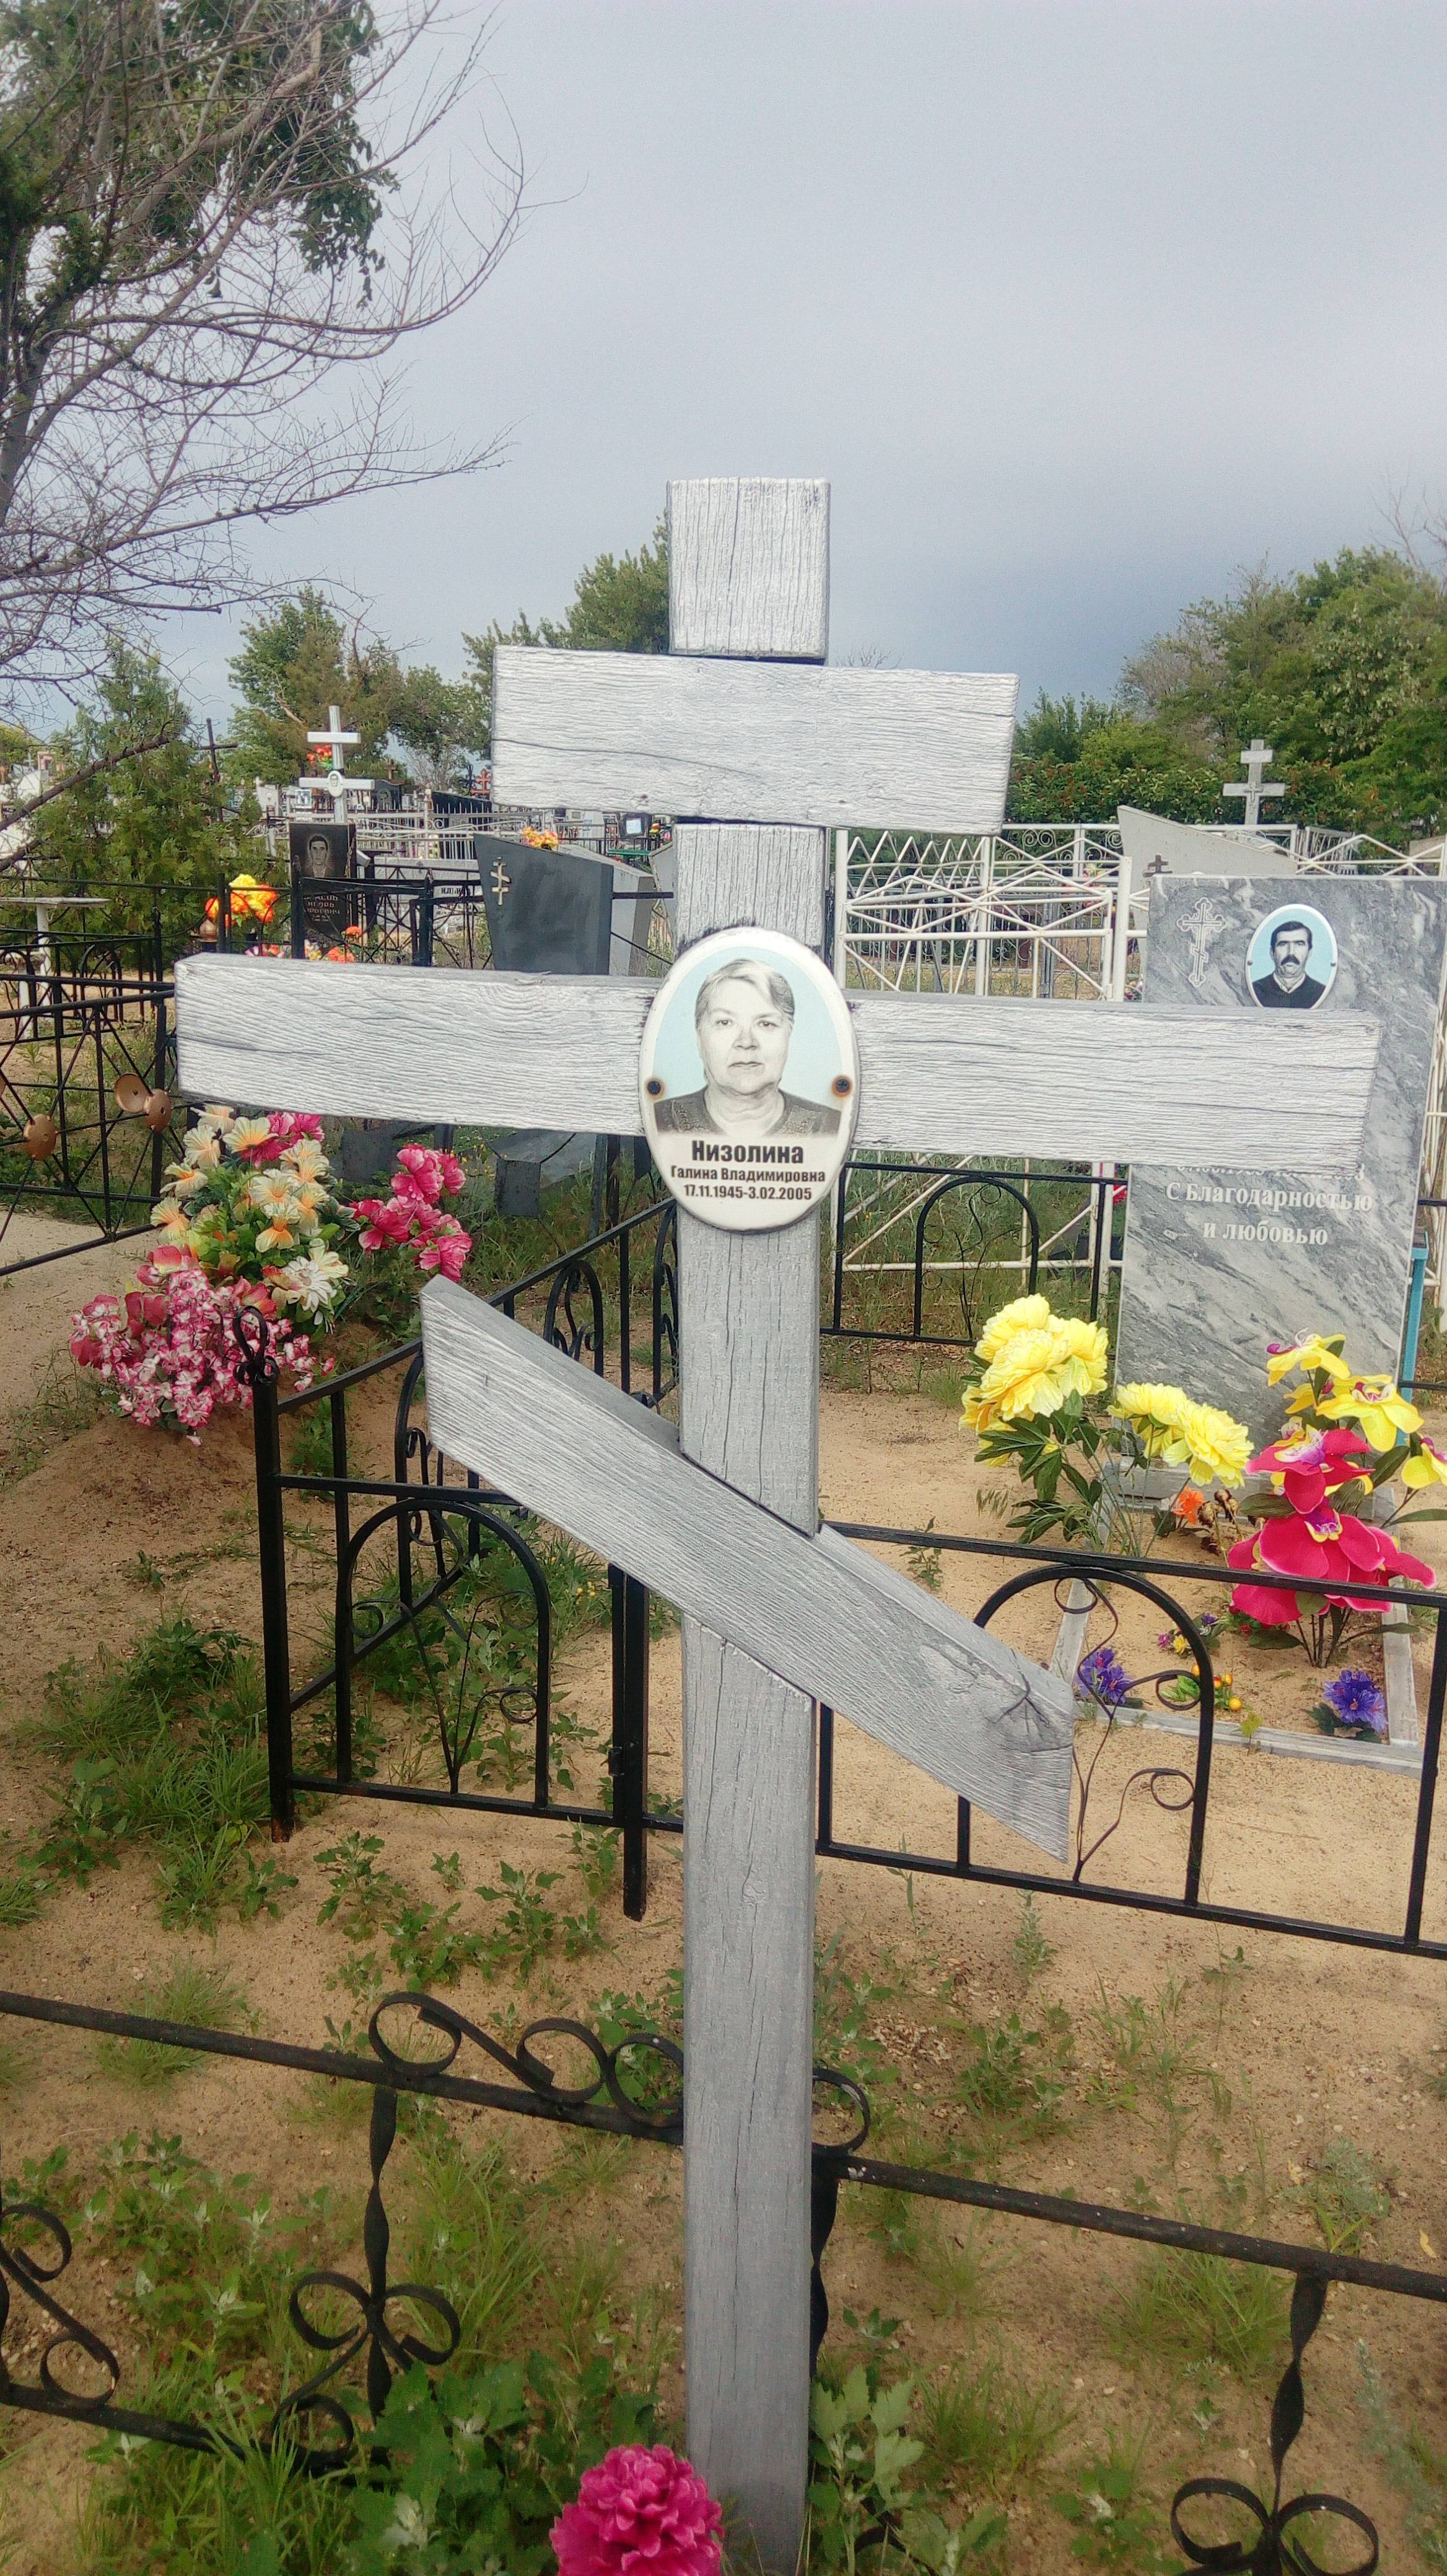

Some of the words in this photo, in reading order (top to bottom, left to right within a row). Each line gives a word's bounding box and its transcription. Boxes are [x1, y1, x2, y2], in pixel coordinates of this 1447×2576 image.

[691, 1139, 804, 1164] Низолина
[671, 1165, 718, 1180] Галина
[721, 1167, 826, 1183] Владимировна
[684, 1183, 812, 1201] 17.11.1945-3.02.2005
[1166, 1181, 1181, 1201] С
[1186, 1182, 1373, 1212] Благодарностью
[1203, 1222, 1217, 1239] и
[1222, 1220, 1329, 1246] любовью
